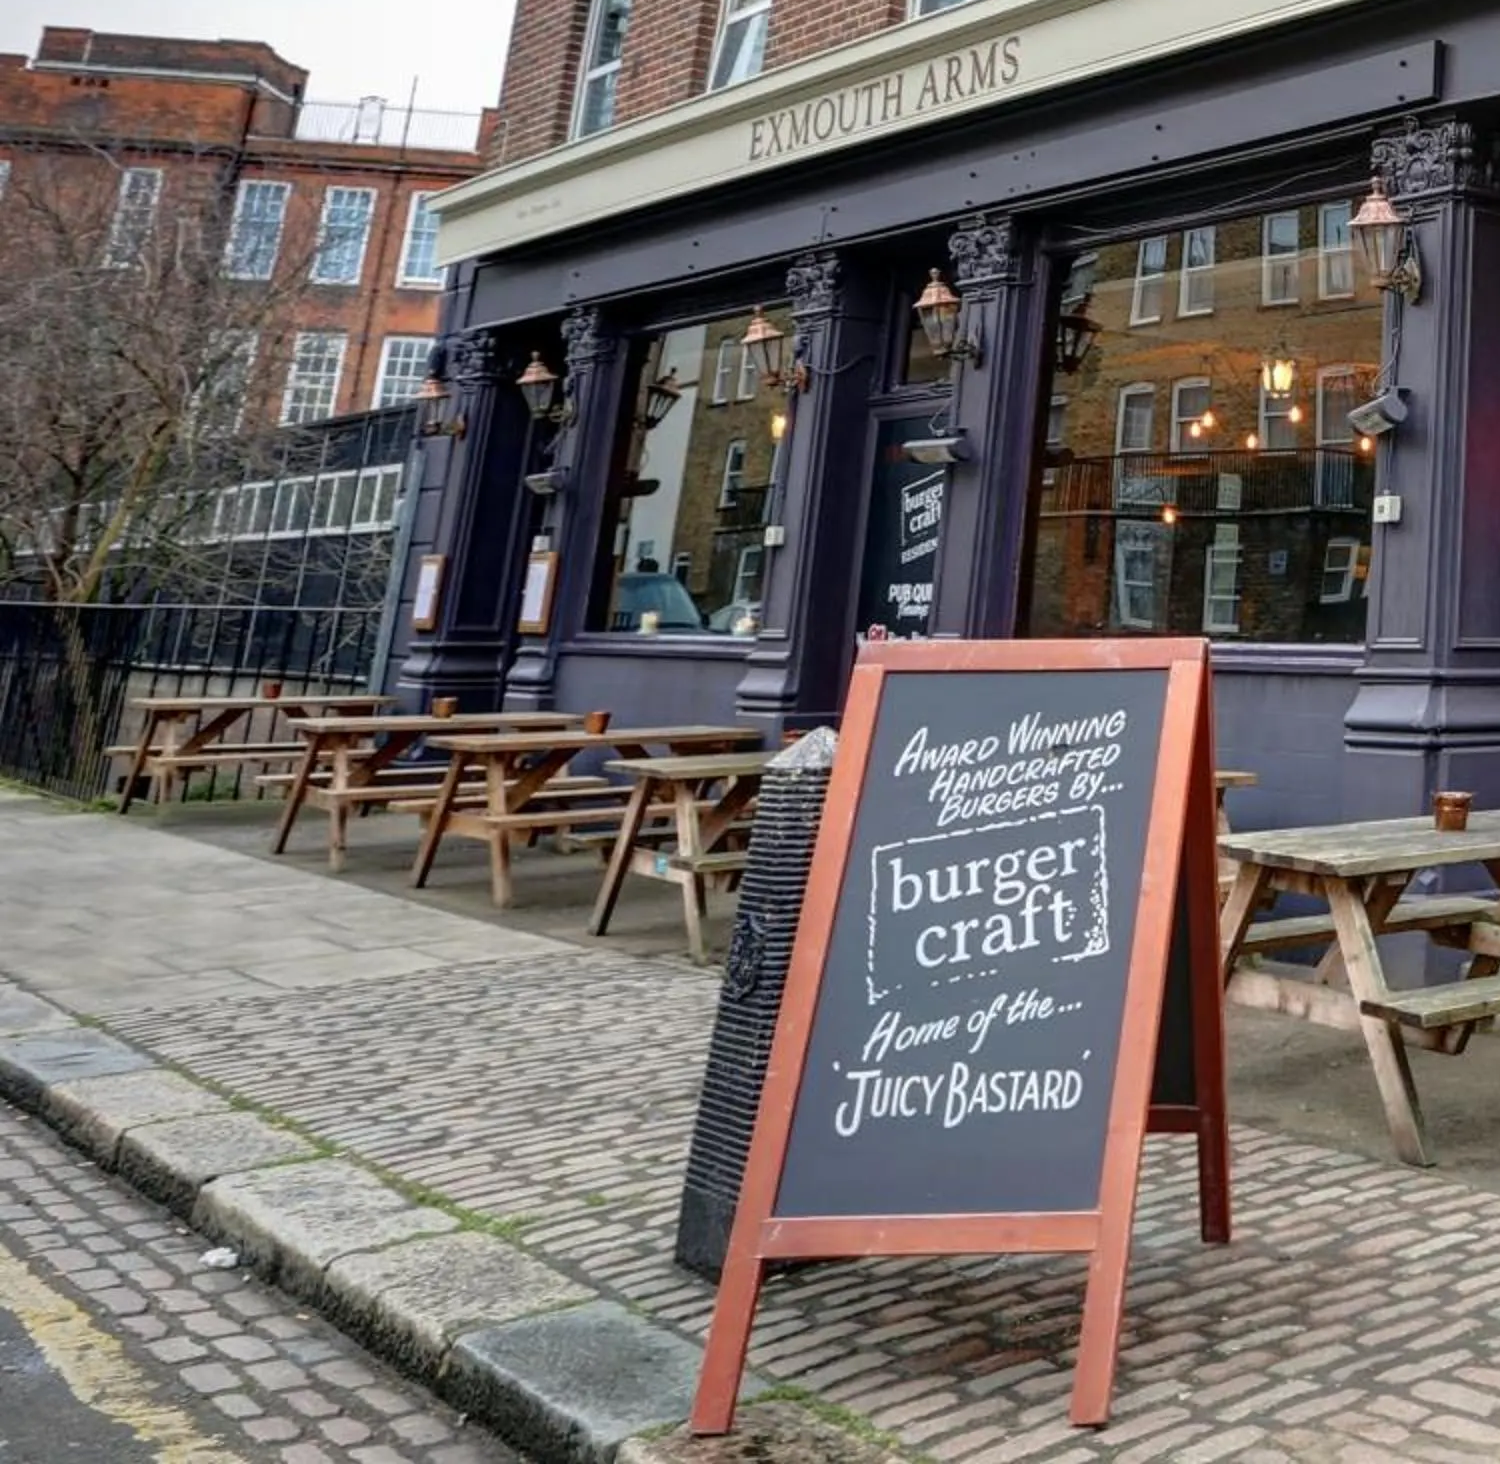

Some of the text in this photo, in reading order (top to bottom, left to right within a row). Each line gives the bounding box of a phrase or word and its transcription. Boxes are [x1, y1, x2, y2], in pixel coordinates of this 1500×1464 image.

[750, 36, 1020, 160] EXMOUTH ARMS
[889, 838, 1086, 912] burger
[915, 886, 1074, 968] craft
[862, 1010, 957, 1062] Home
[968, 994, 1007, 1054] of
